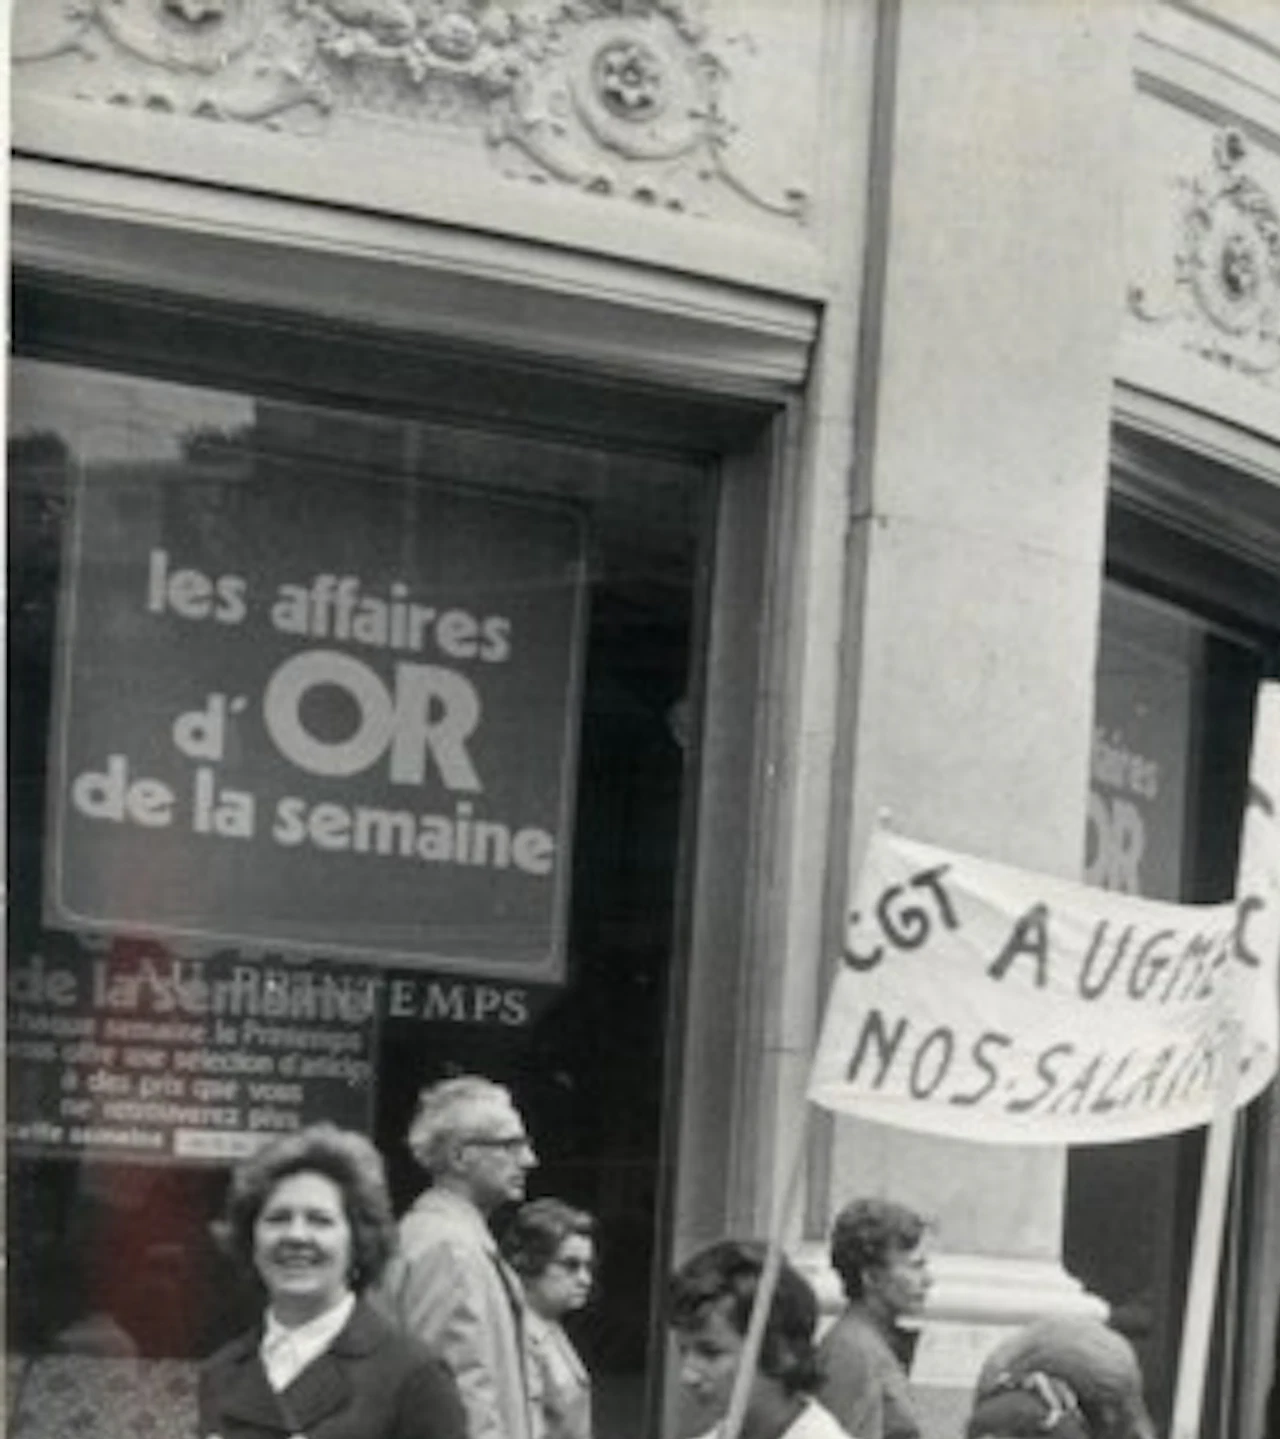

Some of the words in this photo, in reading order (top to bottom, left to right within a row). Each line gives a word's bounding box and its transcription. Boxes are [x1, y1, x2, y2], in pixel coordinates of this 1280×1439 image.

[148, 549, 247, 624] les
[271, 574, 512, 663] affaires
[72, 754, 175, 828] de
[192, 766, 256, 840] la
[271, 801, 556, 876] semaine
